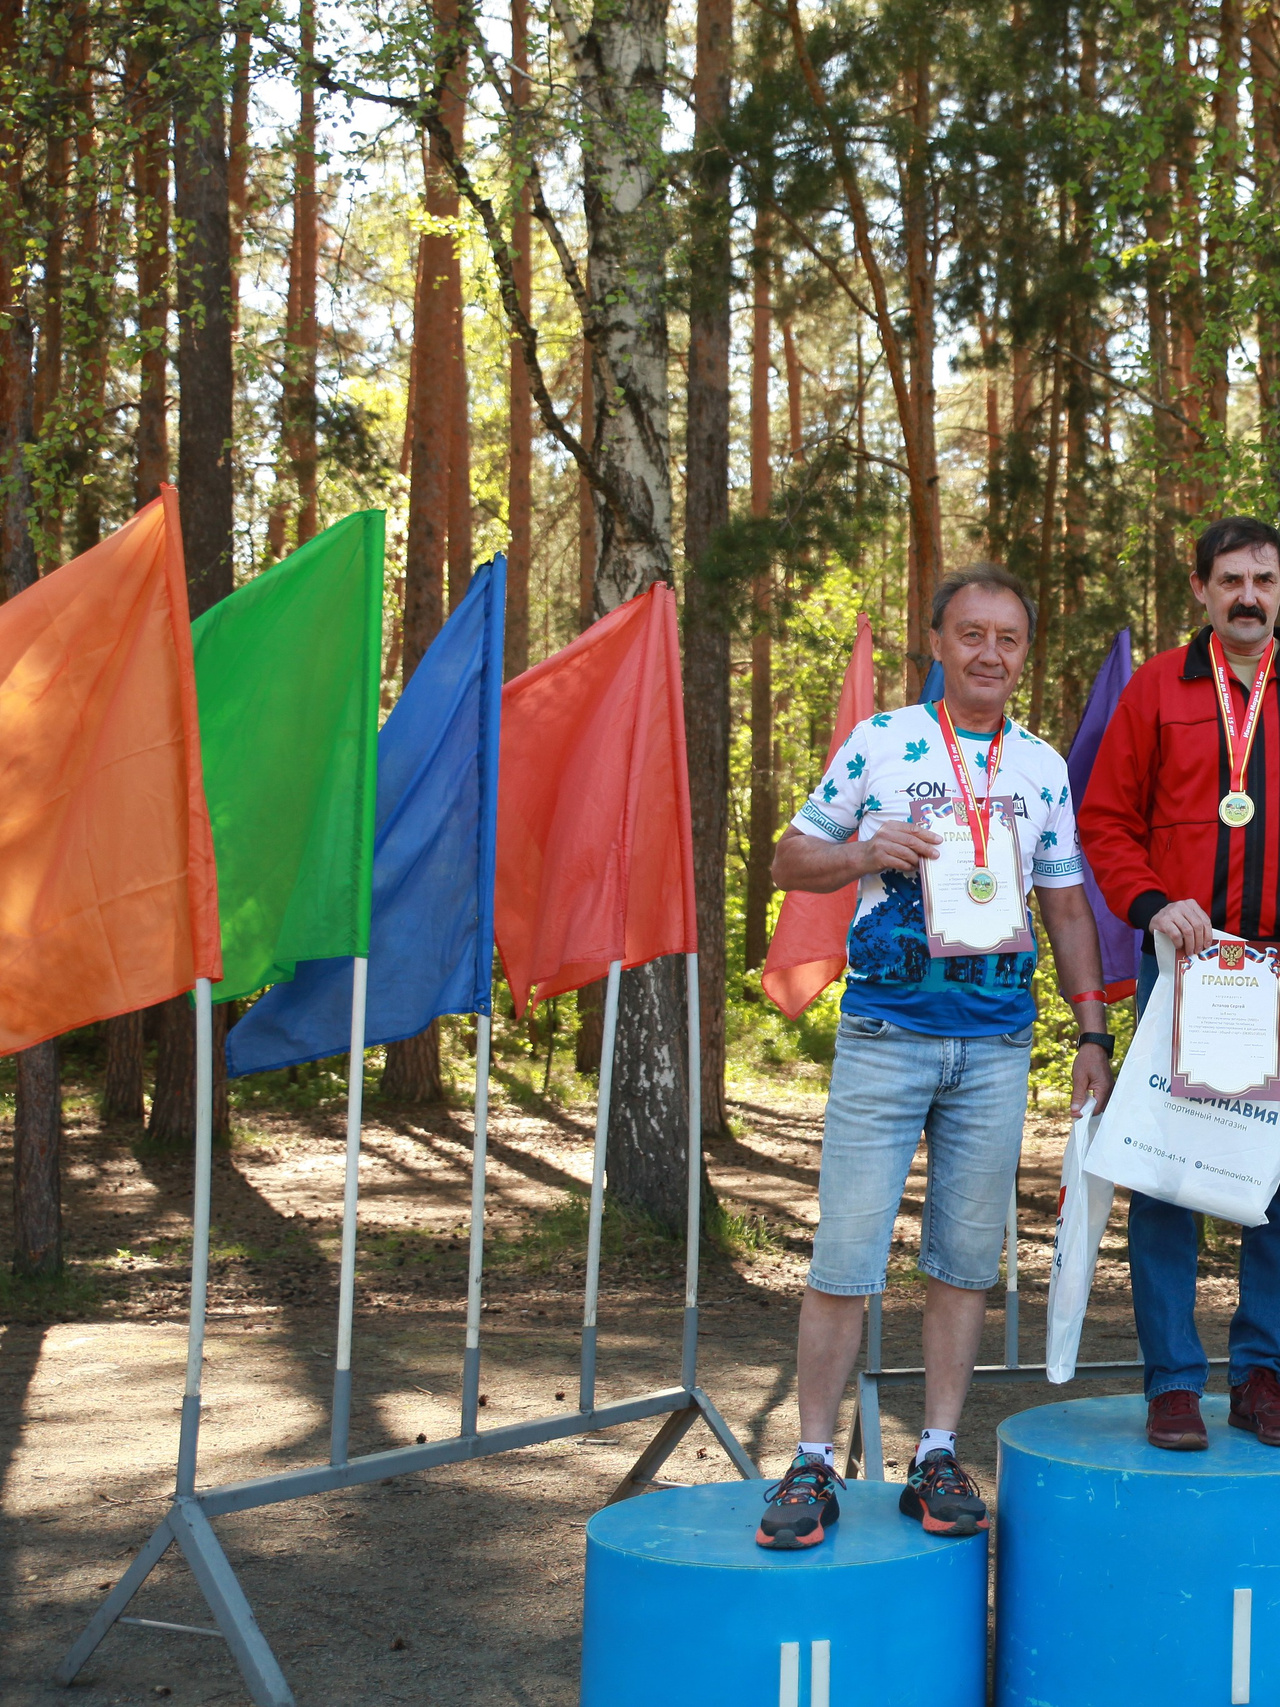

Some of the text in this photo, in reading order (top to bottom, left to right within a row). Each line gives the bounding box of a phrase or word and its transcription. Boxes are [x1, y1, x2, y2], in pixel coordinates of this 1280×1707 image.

[1220, 683, 1226, 692] да
[1223, 692, 1231, 714] Марья
[1250, 690, 1260, 711] Марья
[1249, 711, 1254, 721] да
[1243, 721, 1252, 739] Иван
[944, 831, 995, 842] ГРАМА
[1202, 974, 1259, 988] ГРАМОТА
[1164, 1100, 1248, 1132] спортивный магазин
[1139, 1142, 1152, 1153] 908
[1154, 1147, 1186, 1164] 708-41-14
